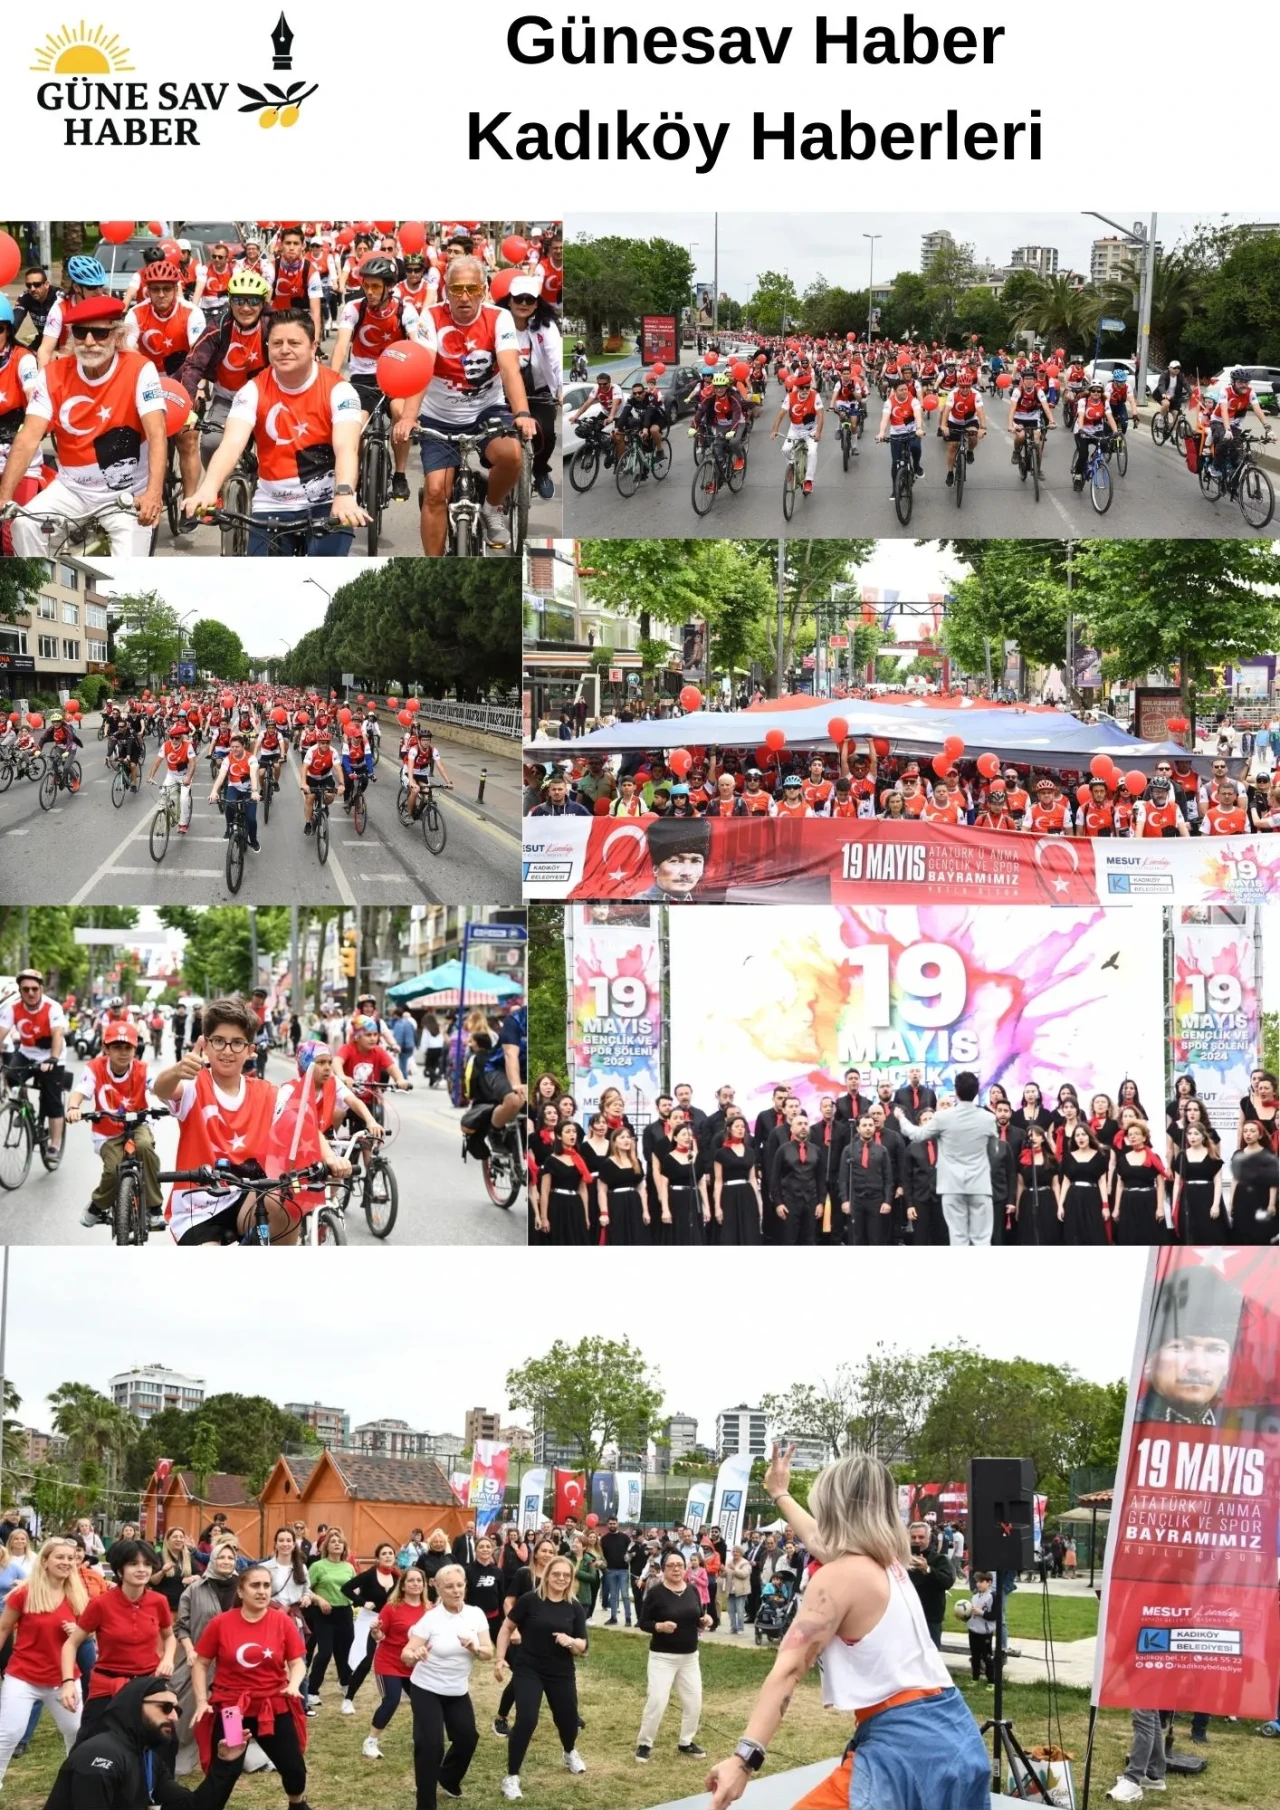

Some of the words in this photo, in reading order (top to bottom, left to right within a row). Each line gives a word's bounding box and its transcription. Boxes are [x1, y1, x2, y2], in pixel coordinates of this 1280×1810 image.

[990, 848, 1019, 861] ANMA
[1106, 857, 1141, 865] MESUT
[841, 843, 864, 879] 19
[866, 843, 926, 882] MAYIS
[975, 861, 988, 872] VE
[993, 861, 1020, 873] SPOR
[1223, 859, 1258, 880] 19
[928, 871, 1019, 885] BAYRAMIMIZ
[847, 941, 967, 1028] 19
[587, 976, 647, 1018] 19
[1185, 973, 1242, 1014] 19
[583, 1018, 653, 1034] MAYIS
[1181, 1013, 1249, 1030] MAYIS
[583, 1035, 635, 1047] GENÇLİK
[637, 1036, 652, 1046] VE
[1181, 1030, 1231, 1042] GENÇLİK
[1233, 1031, 1249, 1040] VE
[583, 1047, 612, 1056] SPOR
[614, 1045, 653, 1057] ŞÖLENİ
[837, 1028, 980, 1064] MAYIS
[1181, 1041, 1209, 1050] SPOR
[1211, 1040, 1249, 1052] ŞÖLENİ
[603, 1056, 633, 1067] 2024
[1200, 1051, 1228, 1061] 2024
[1137, 1437, 1171, 1488] 19
[1174, 1441, 1265, 1497] MAYIS
[475, 1477, 499, 1494] 19
[1130, 1495, 1211, 1516] ATATÜRK'Ü
[1217, 1502, 1262, 1518] ANMA
[1128, 1510, 1190, 1529] GENÇLİK
[1198, 1516, 1213, 1531] VE
[1219, 1518, 1262, 1534] SPOR
[1125, 1526, 1262, 1549] BAYRAMIMIZ
[1142, 1605, 1192, 1617] MESUT
[1176, 1631, 1220, 1639] KADIKÖY
[1176, 1643, 1233, 1652] BELEDİYESİ
